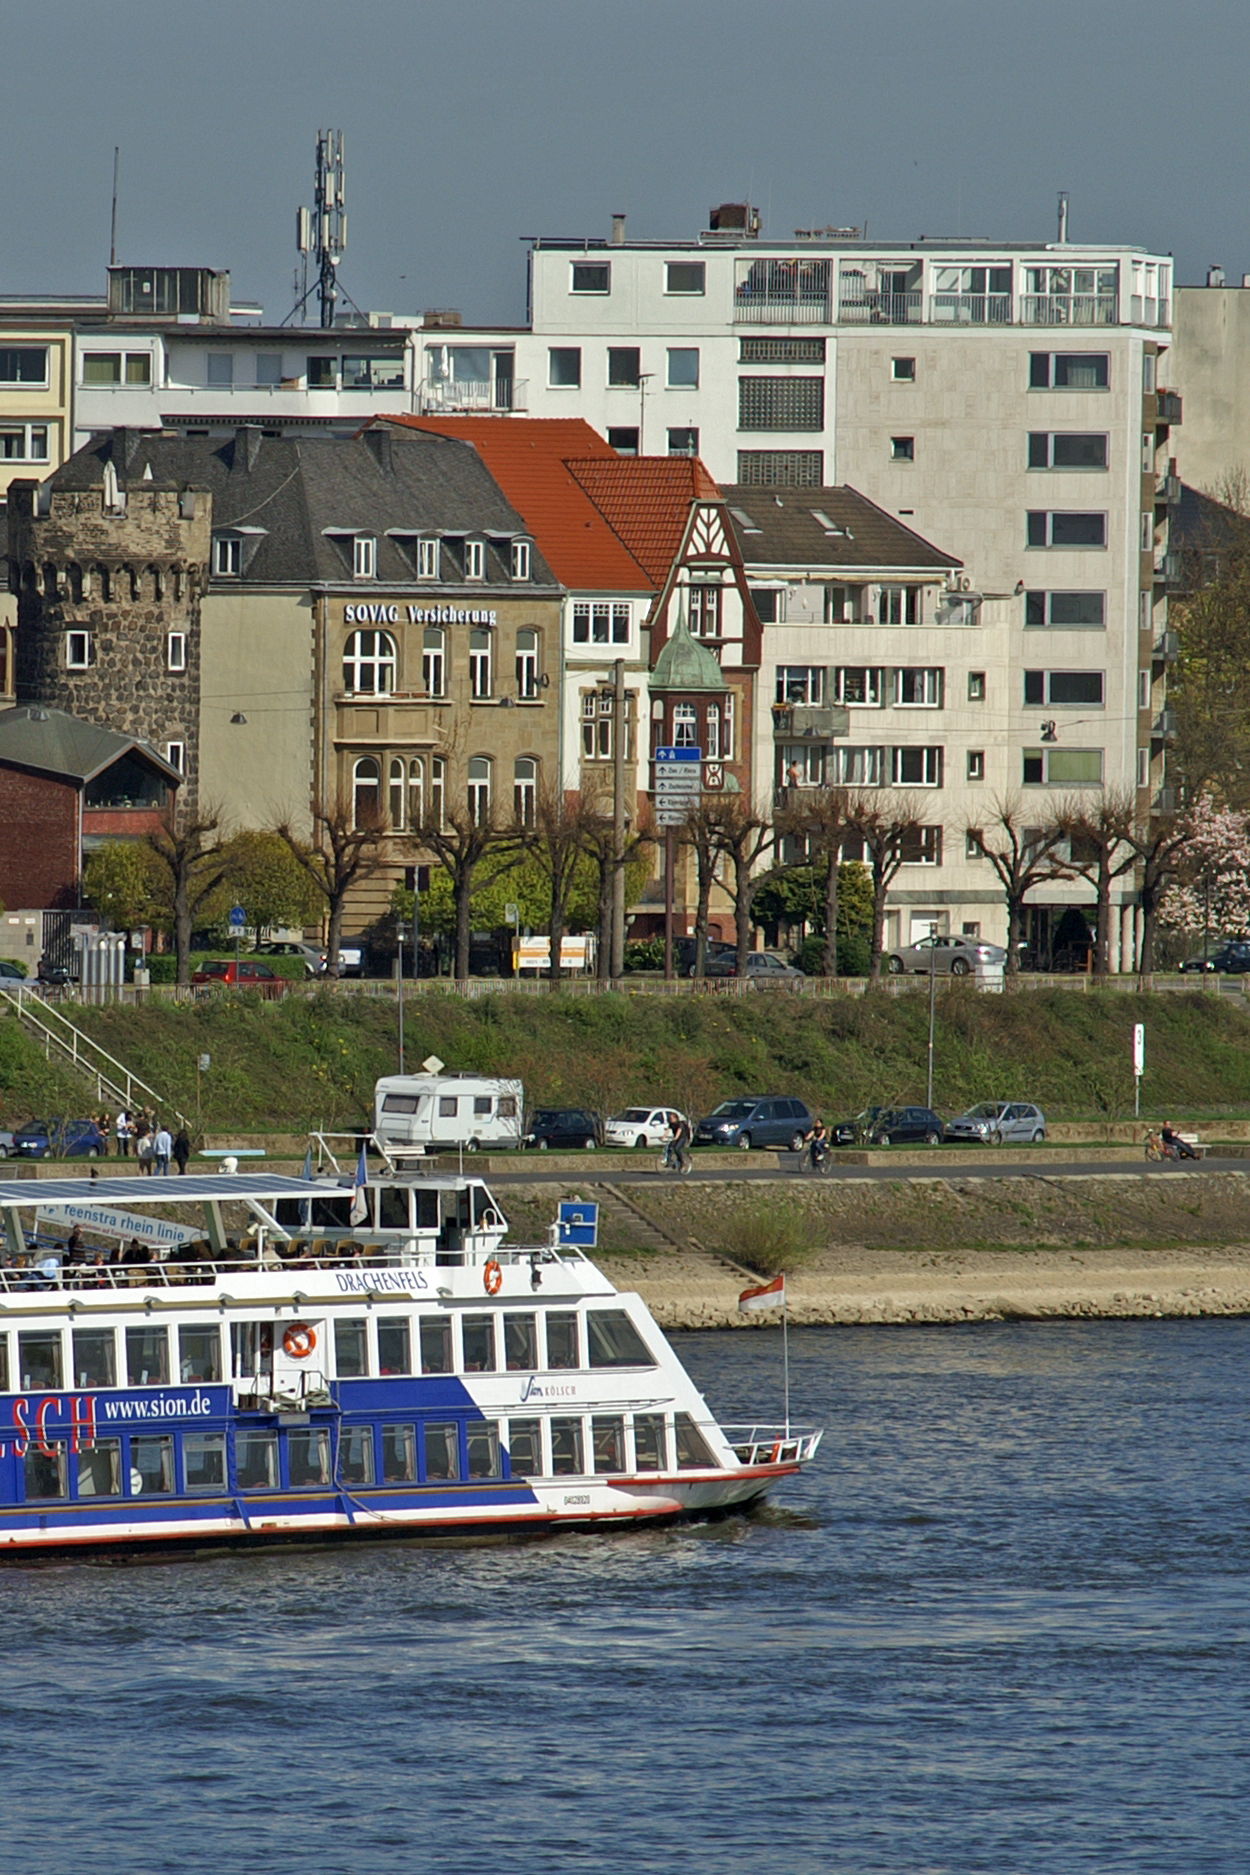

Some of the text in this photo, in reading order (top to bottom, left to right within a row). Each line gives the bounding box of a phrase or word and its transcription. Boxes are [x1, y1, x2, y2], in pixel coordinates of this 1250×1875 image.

[345, 604, 497, 626] SOVAG Versicherung
[64, 1204, 117, 1227] feenstra
[120, 1215, 154, 1235] rhein
[157, 1222, 186, 1242] linie
[335, 1270, 429, 1292] DRACHENFELS
[105, 1388, 211, 1419] www.sion.de
